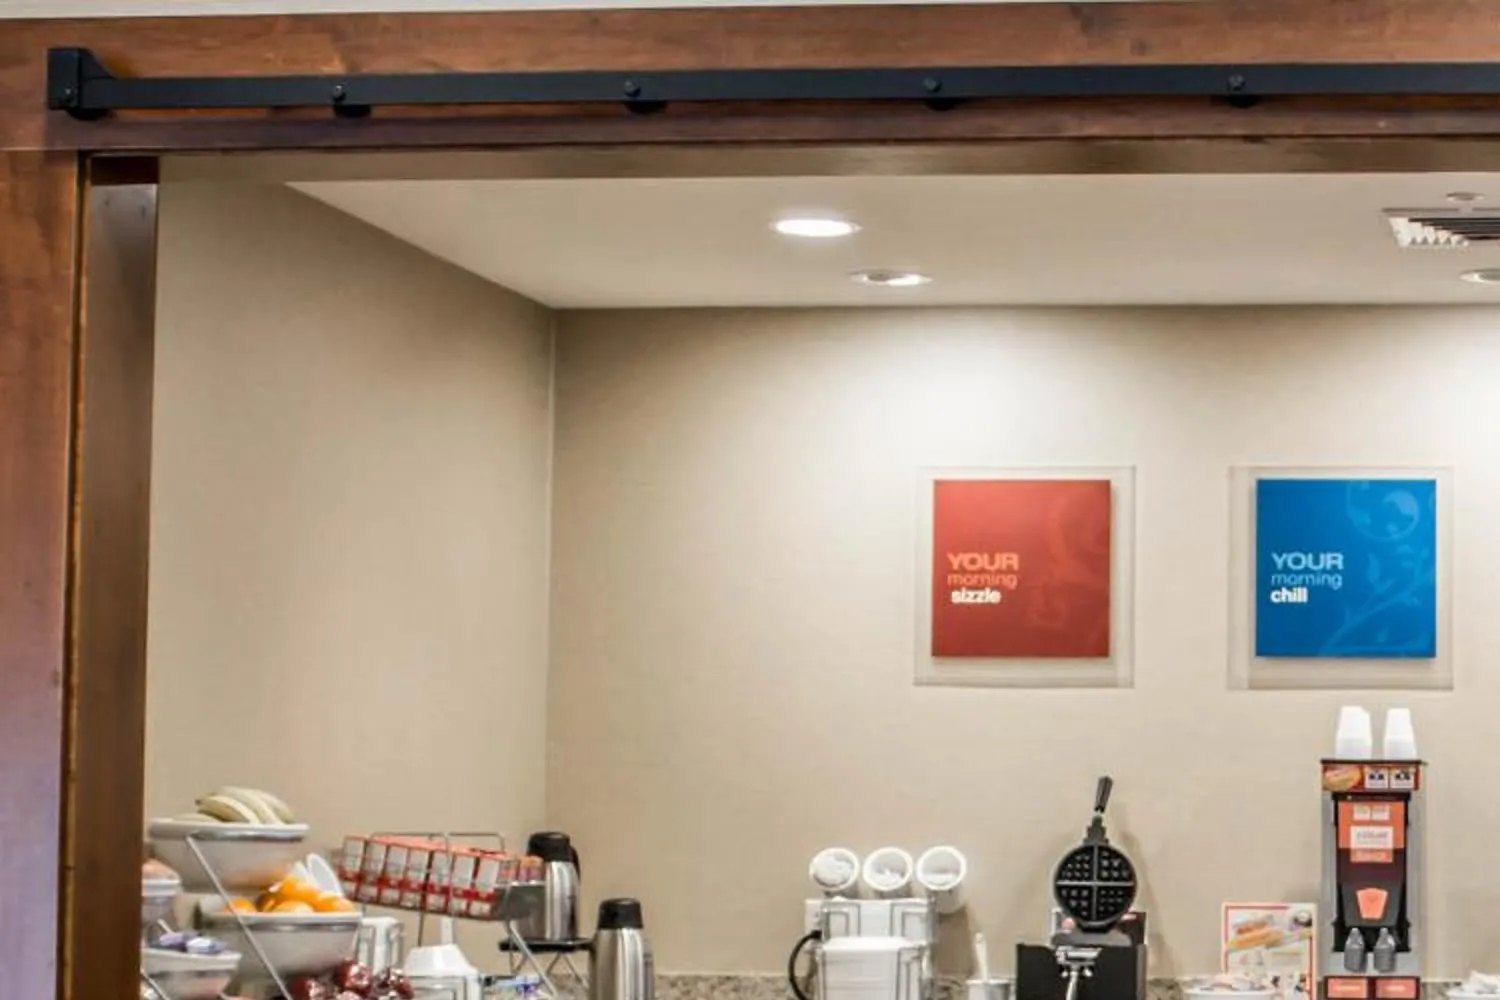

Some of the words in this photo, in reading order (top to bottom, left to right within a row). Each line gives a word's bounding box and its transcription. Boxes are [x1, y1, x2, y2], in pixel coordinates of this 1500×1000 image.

[947, 552, 1019, 571] YOUR
[1271, 552, 1344, 571] YOUR
[947, 573, 1018, 590] morning
[1271, 573, 1343, 591] morning
[951, 587, 1002, 604] sizzle
[1270, 587, 1308, 604] chill
